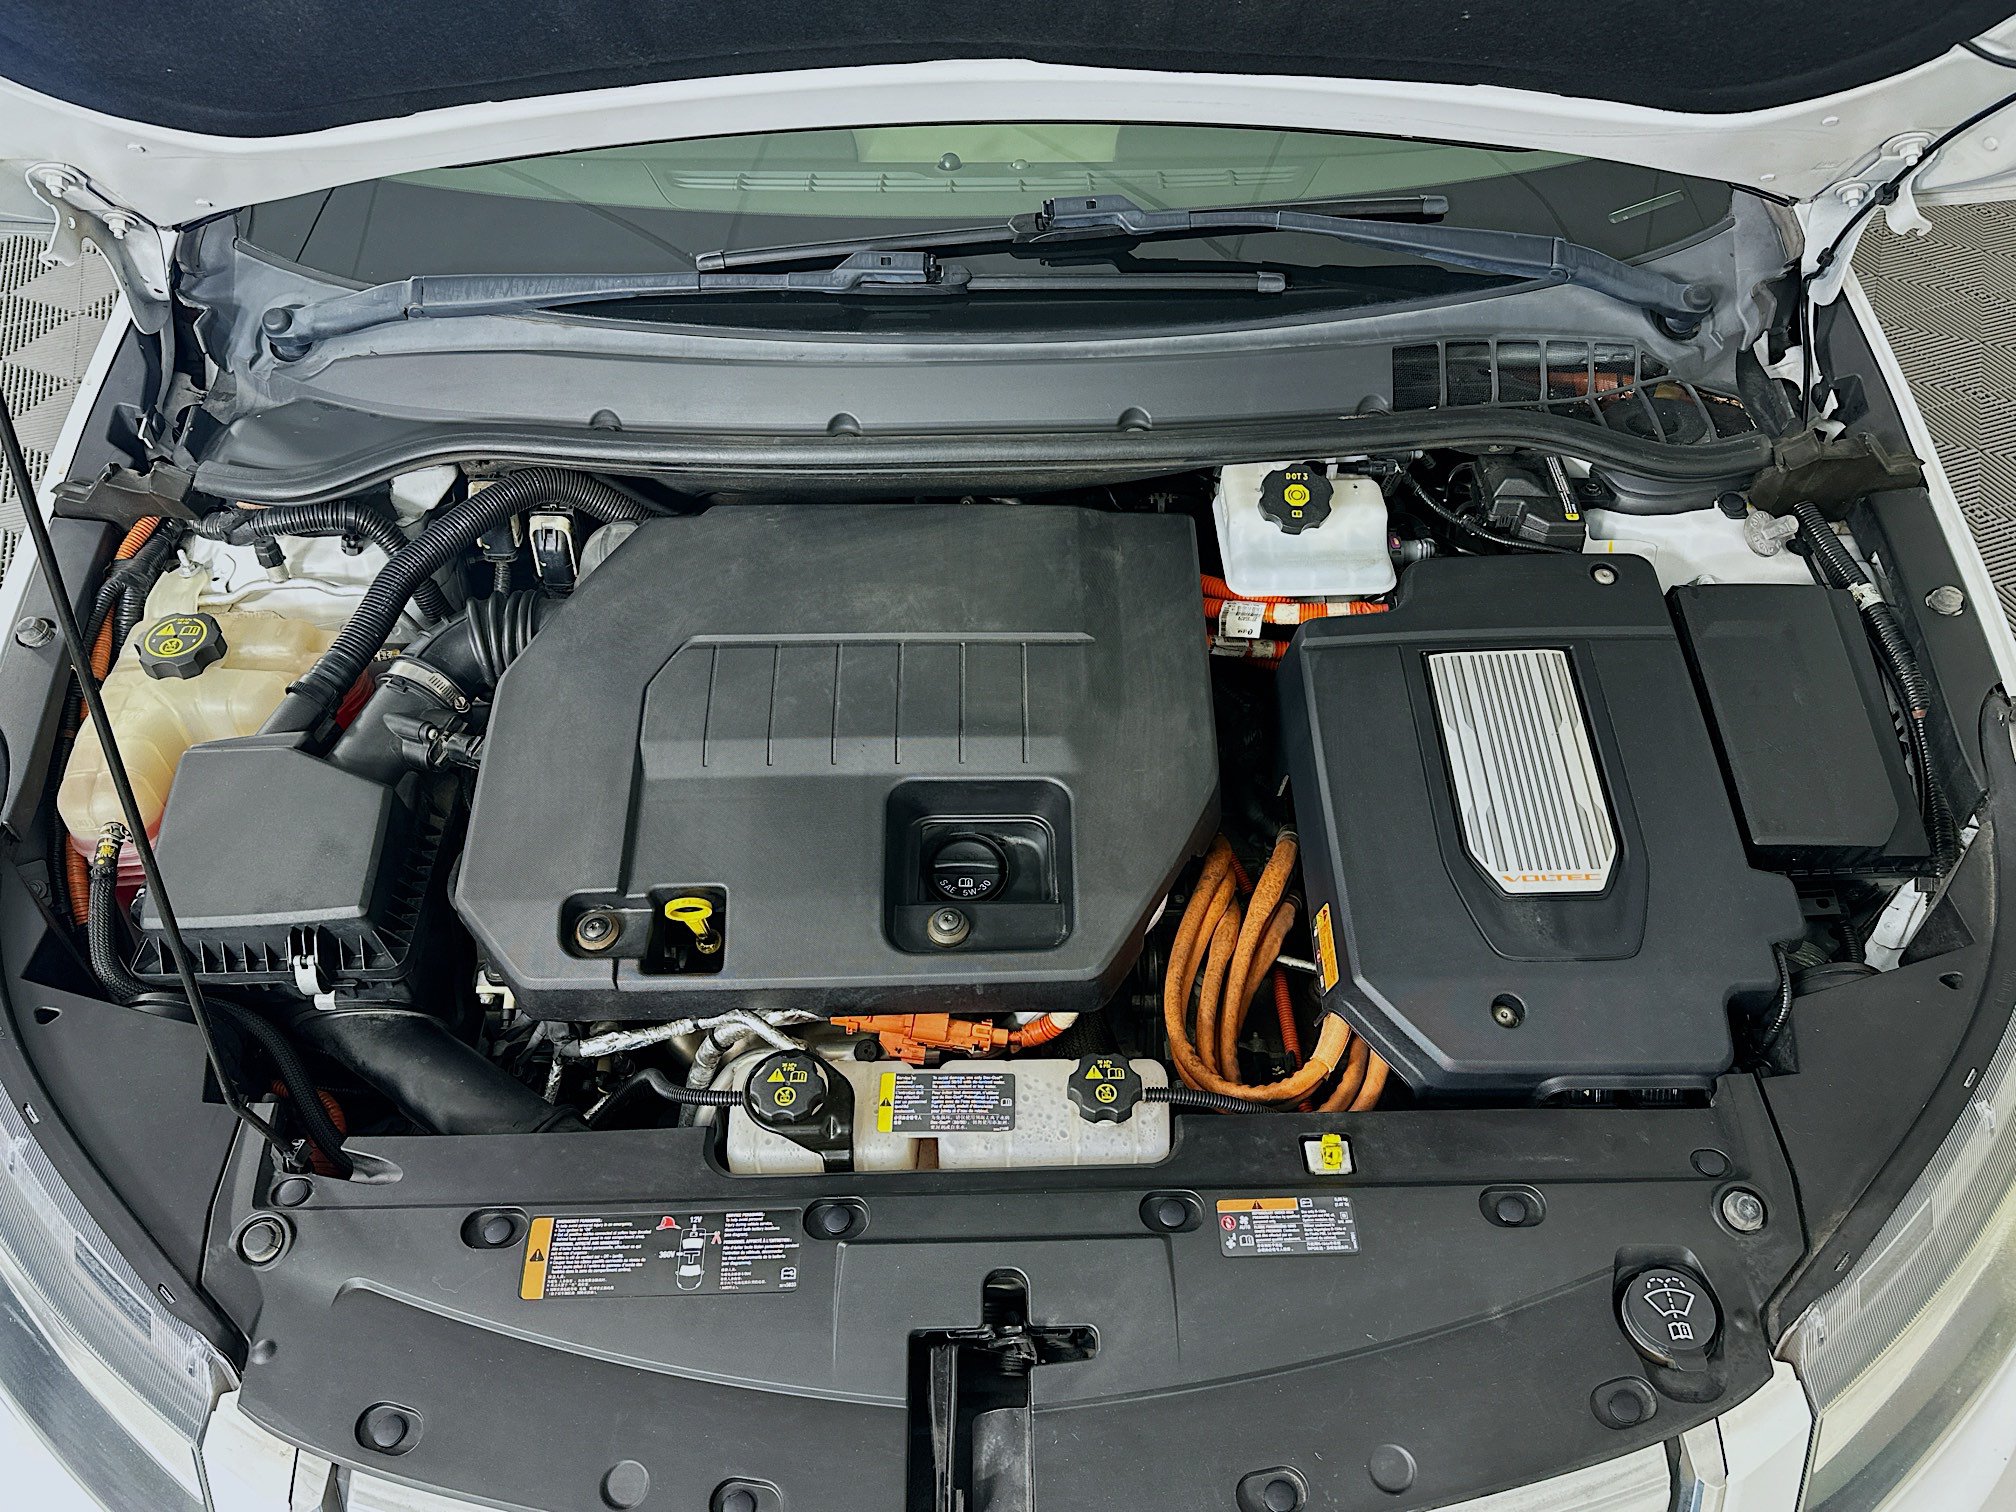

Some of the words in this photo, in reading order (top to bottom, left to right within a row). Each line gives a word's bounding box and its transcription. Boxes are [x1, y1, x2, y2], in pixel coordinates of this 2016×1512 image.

[1303, 472, 1309, 480] 3
[1502, 874, 1602, 882] VOLTEC
[940, 879, 957, 894] SAE
[962, 879, 991, 897] 5W-30
[690, 1216, 702, 1224] 12V
